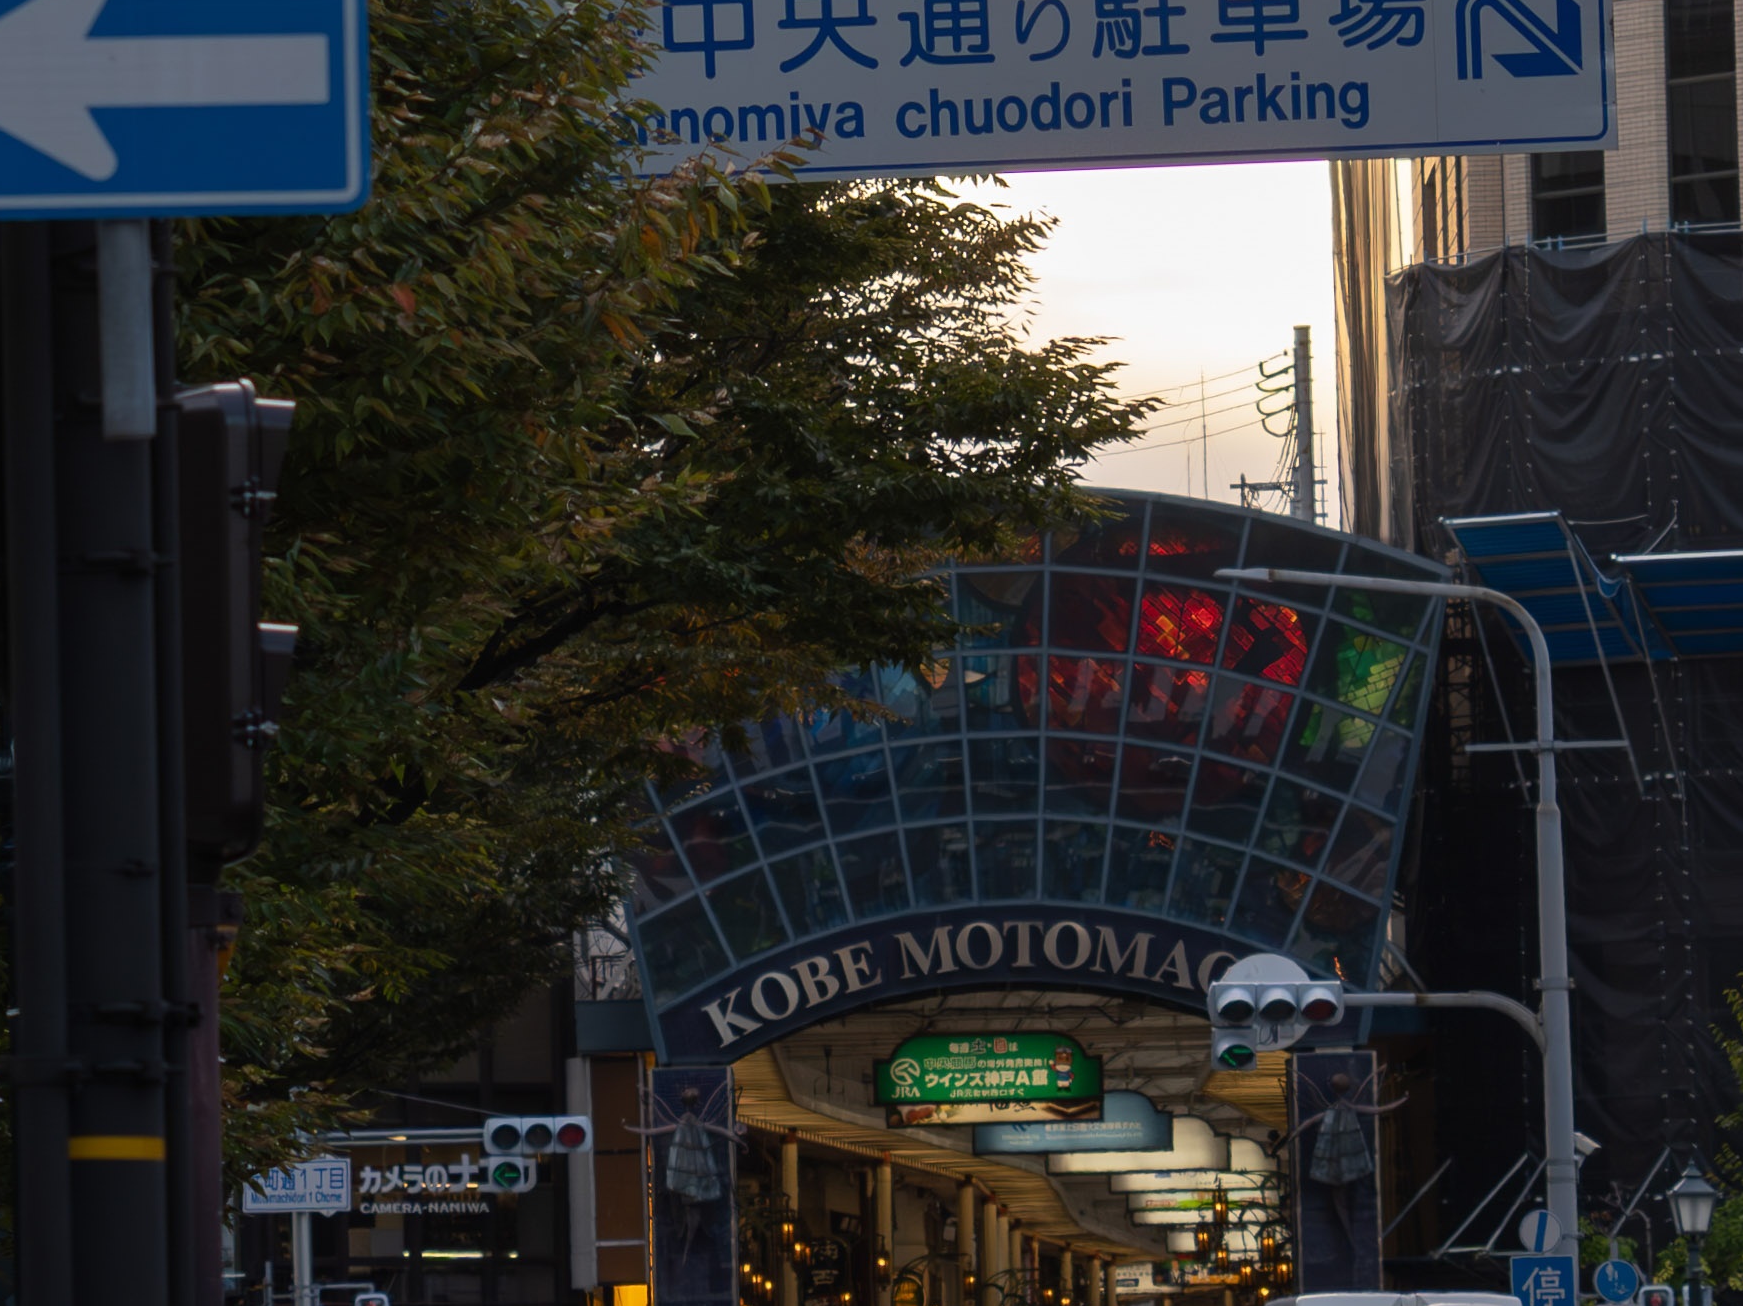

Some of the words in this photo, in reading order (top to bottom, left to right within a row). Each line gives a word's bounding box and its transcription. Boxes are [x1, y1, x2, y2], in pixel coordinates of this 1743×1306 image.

[636, 91, 867, 151] nnomiya
[895, 78, 1134, 141] chuodori
[1161, 75, 1372, 131] Parking
[700, 939, 884, 1049] KOBE
[894, 920, 1242, 995] MOTOMAC
[890, 1086, 921, 1099] JRA
[253, 1167, 345, 1191] 町通1丁目
[360, 1153, 538, 1194] カメラのナ
[360, 1201, 490, 1215] CAMERA-NANIWA
